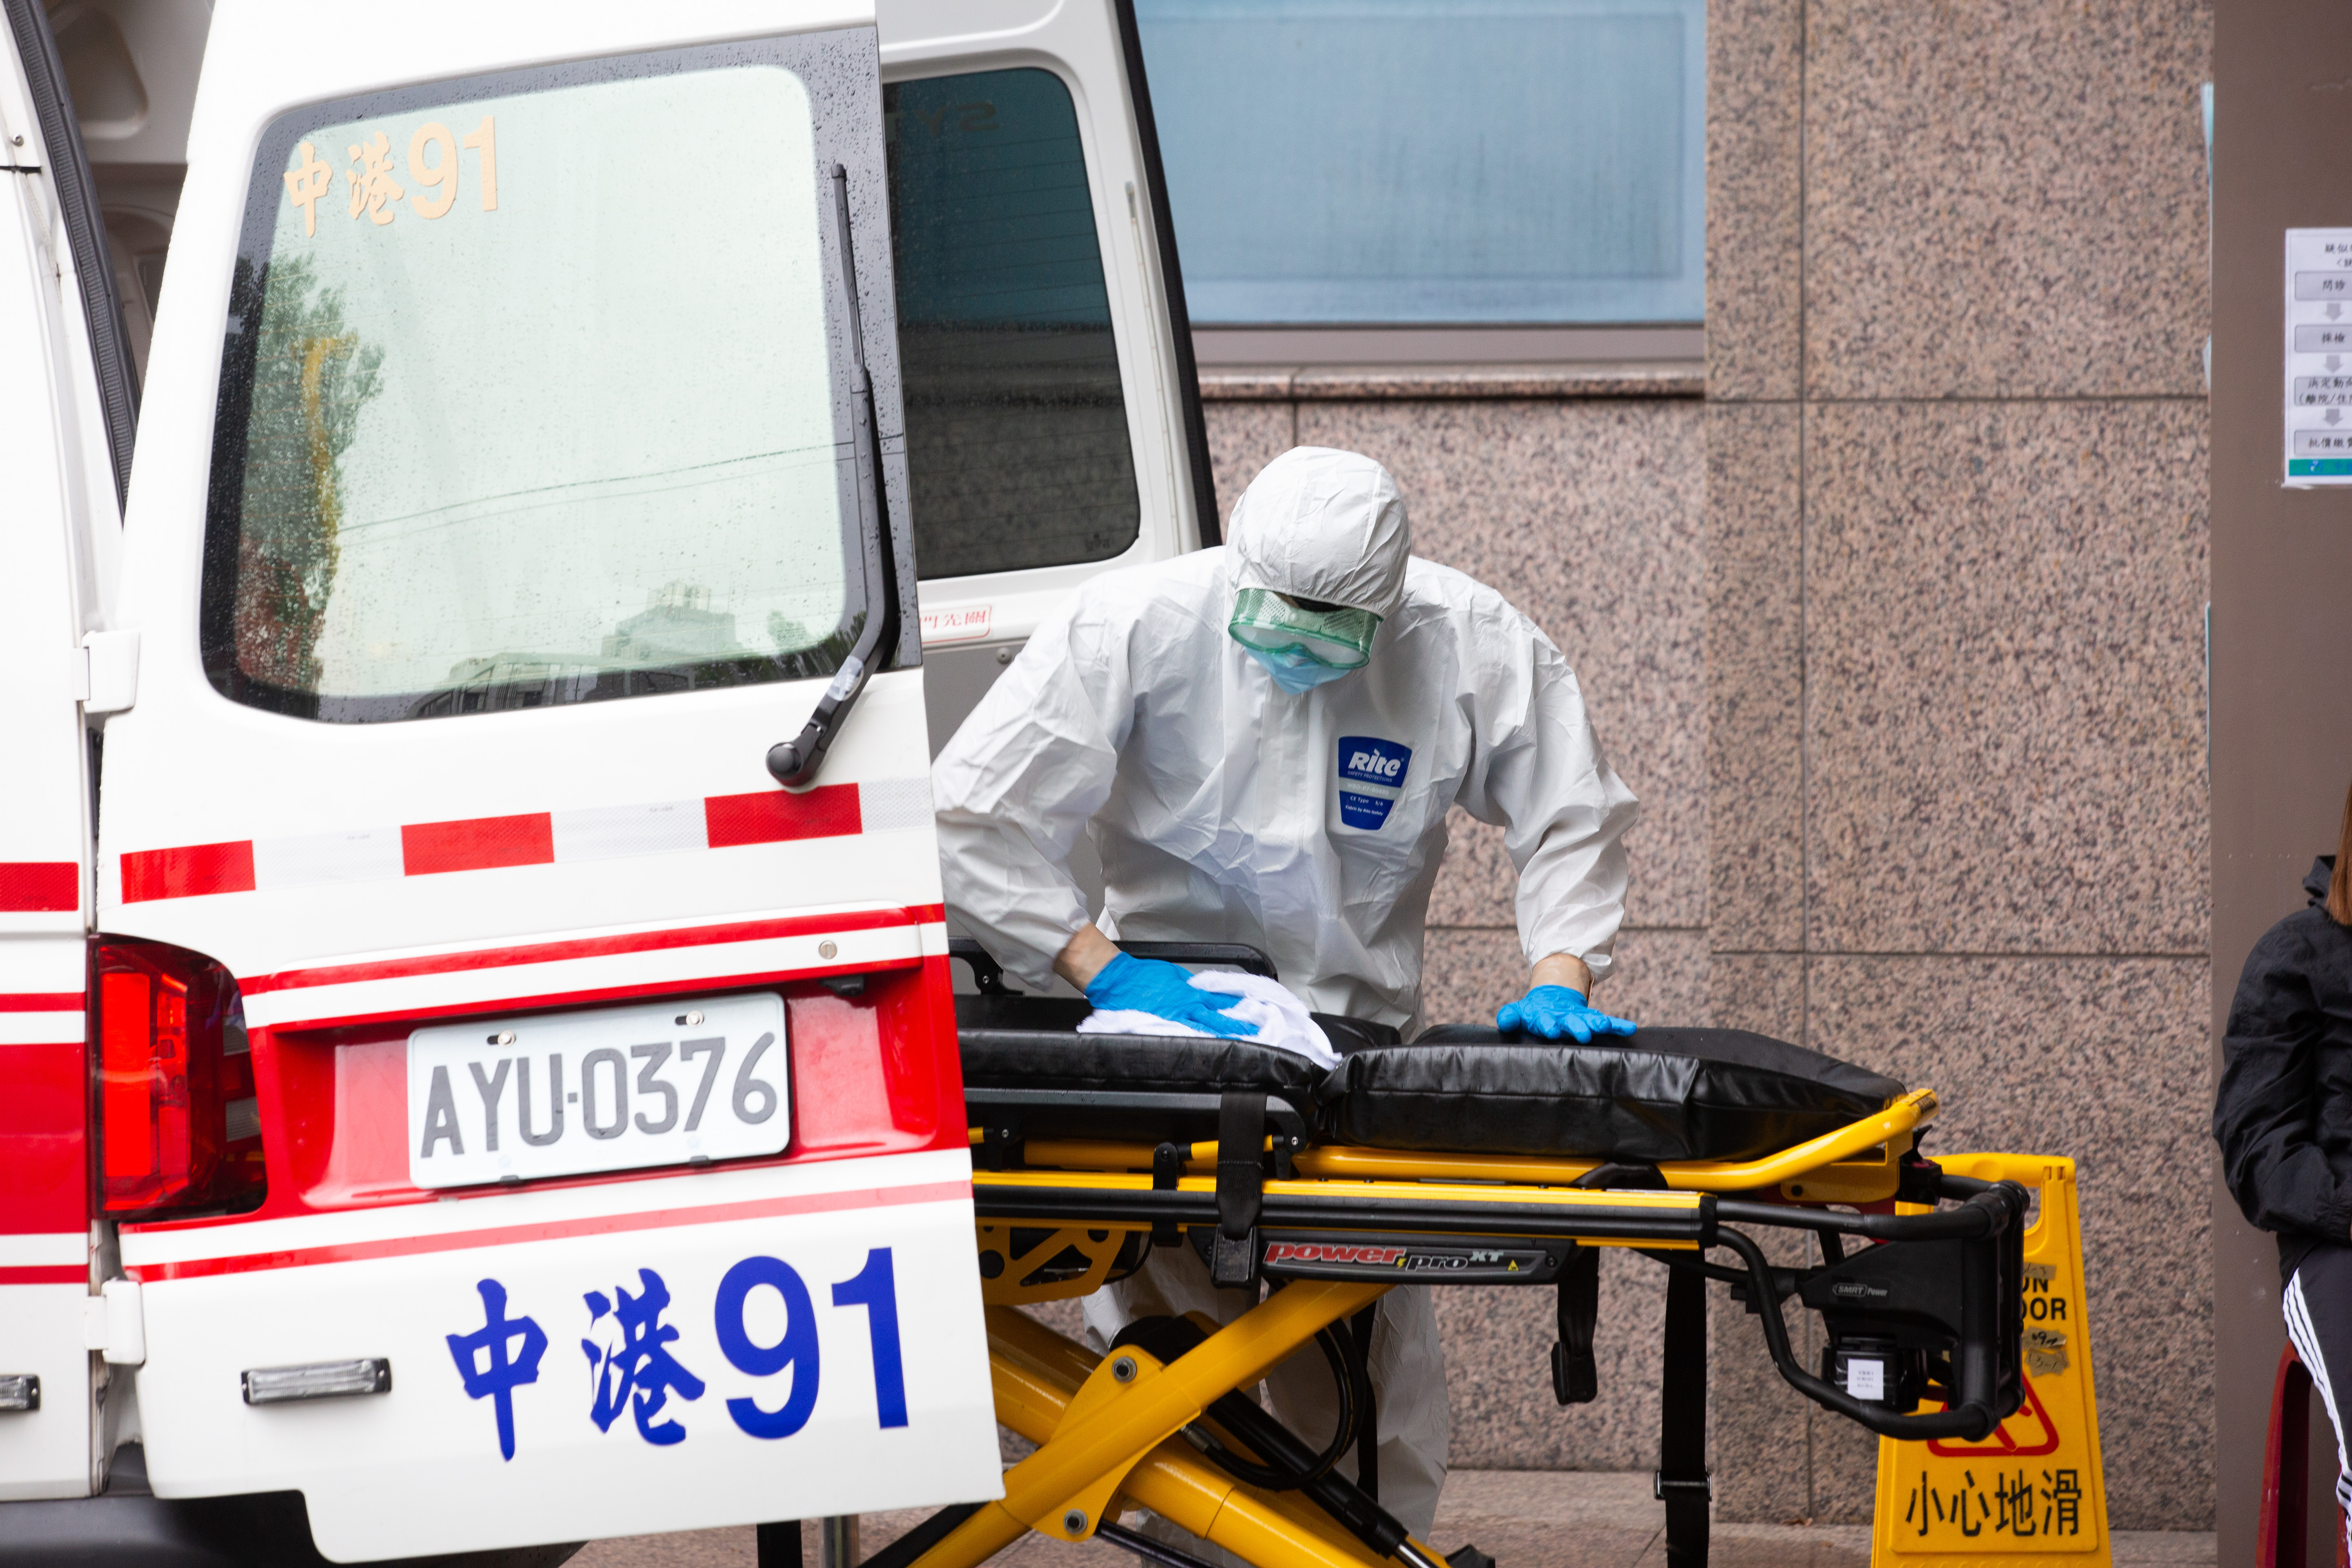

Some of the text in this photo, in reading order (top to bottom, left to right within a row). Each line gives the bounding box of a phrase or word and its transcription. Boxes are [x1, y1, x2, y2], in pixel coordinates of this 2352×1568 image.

[283, 116, 498, 238] 中港91
[1364, 773, 1393, 783] PROTECTIONS
[1263, 1242, 1504, 1272] power pro XT
[445, 1247, 908, 1462] 中港91
[1906, 1469, 2081, 1537] 小心地滑
